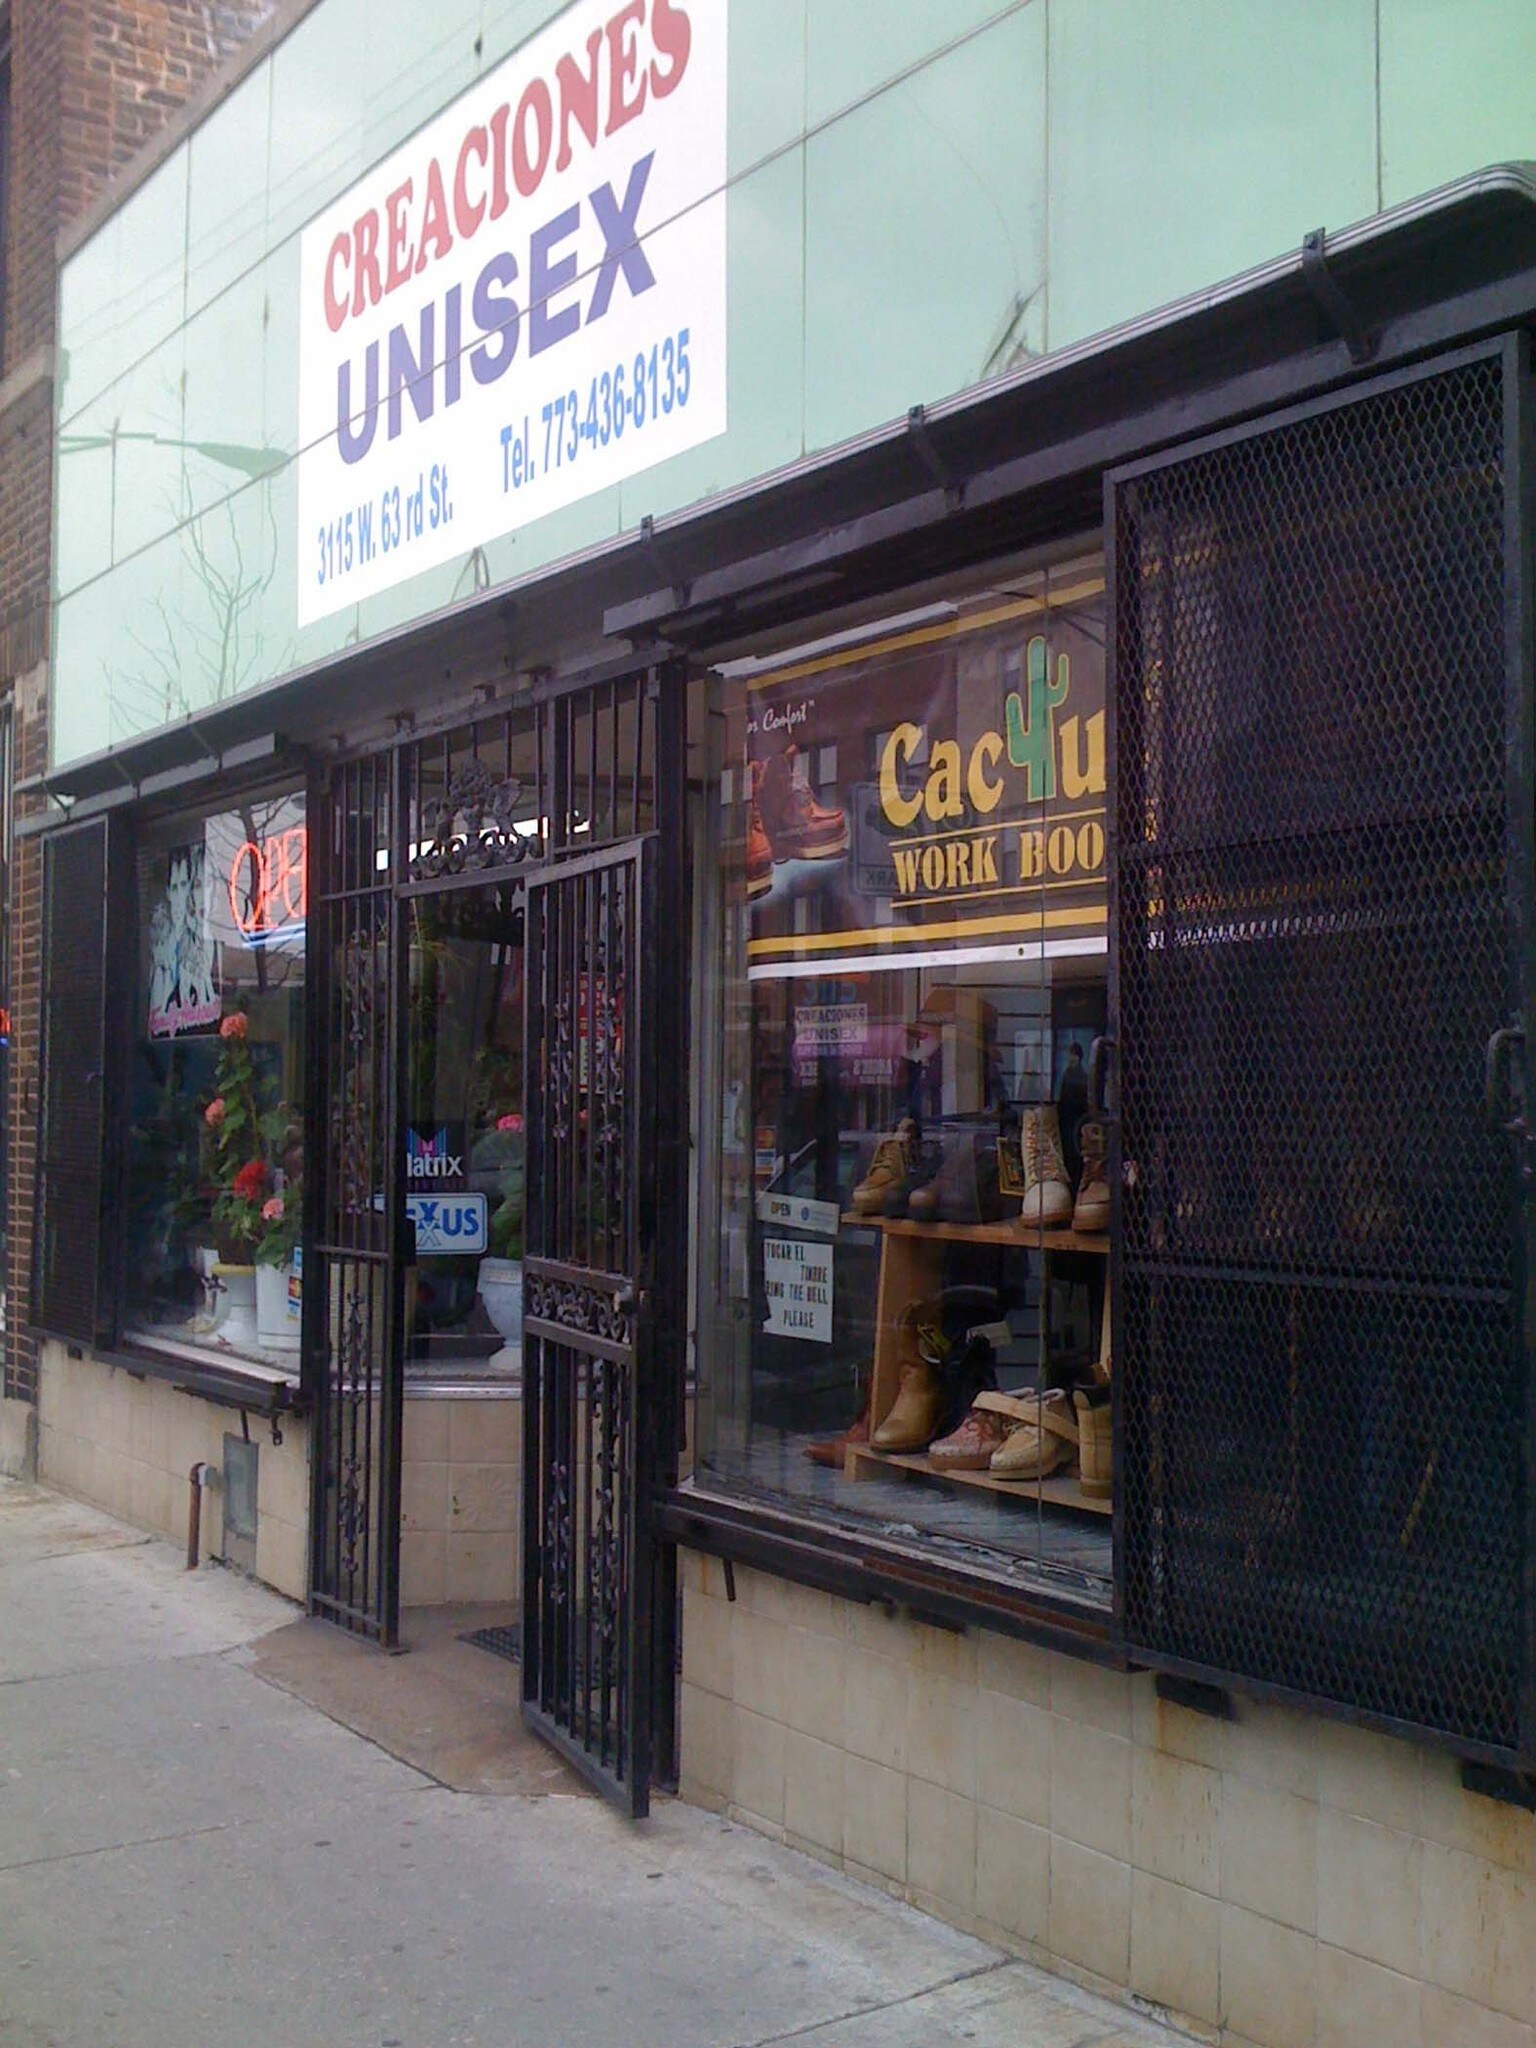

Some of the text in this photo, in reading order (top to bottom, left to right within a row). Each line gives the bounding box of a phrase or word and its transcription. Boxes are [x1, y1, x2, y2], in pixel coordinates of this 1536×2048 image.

[323, 0, 691, 332] CREACIONES
[337, 149, 657, 465] UNISEX
[500, 328, 691, 493] Tel. 773-436-8135
[318, 463, 453, 585] 3115 W. 63 rd St.
[879, 635, 1106, 827] Cactu
[229, 829, 307, 932] OPE
[892, 822, 1104, 895] WORK BOO
